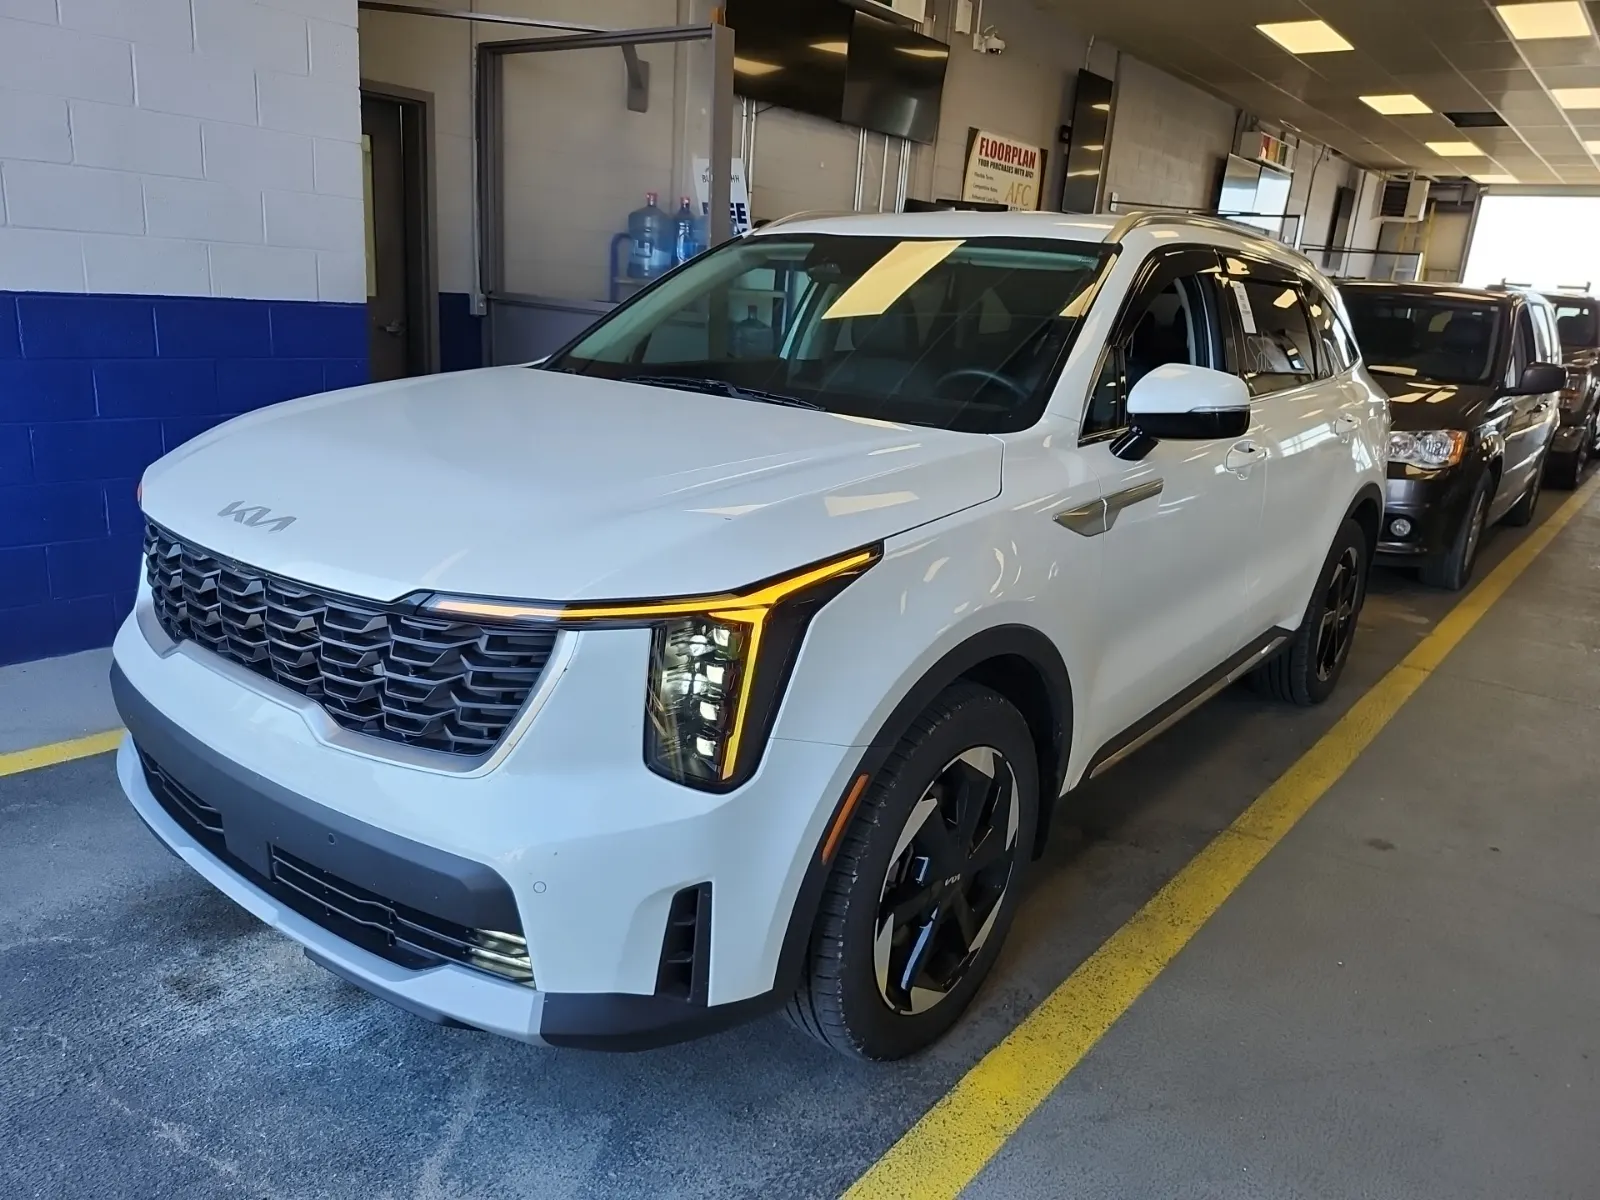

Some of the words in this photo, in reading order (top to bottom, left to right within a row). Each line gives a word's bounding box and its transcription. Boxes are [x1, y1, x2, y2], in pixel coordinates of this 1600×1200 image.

[979, 137, 1037, 169] FLOORPLAN
[977, 158, 990, 167] YOUR
[990, 161, 1014, 174] PURCHASES
[1014, 167, 1025, 177] WITH
[1004, 181, 1031, 206] AFC
